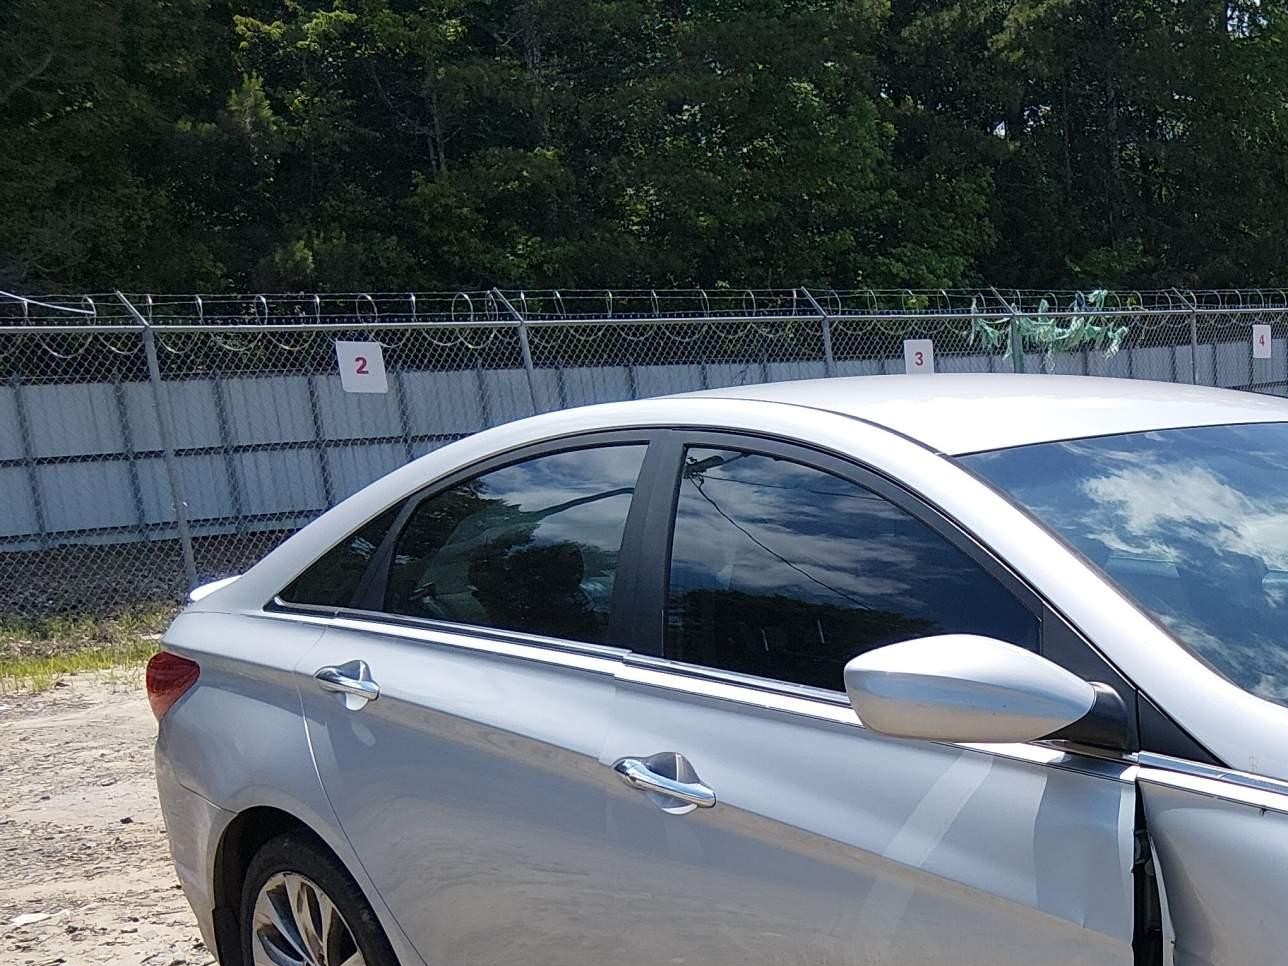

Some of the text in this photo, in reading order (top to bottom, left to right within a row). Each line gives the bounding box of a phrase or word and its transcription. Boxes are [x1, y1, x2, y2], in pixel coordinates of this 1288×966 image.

[1258, 334, 1266, 347] 4
[354, 356, 369, 375] 2
[914, 351, 924, 367] 3
